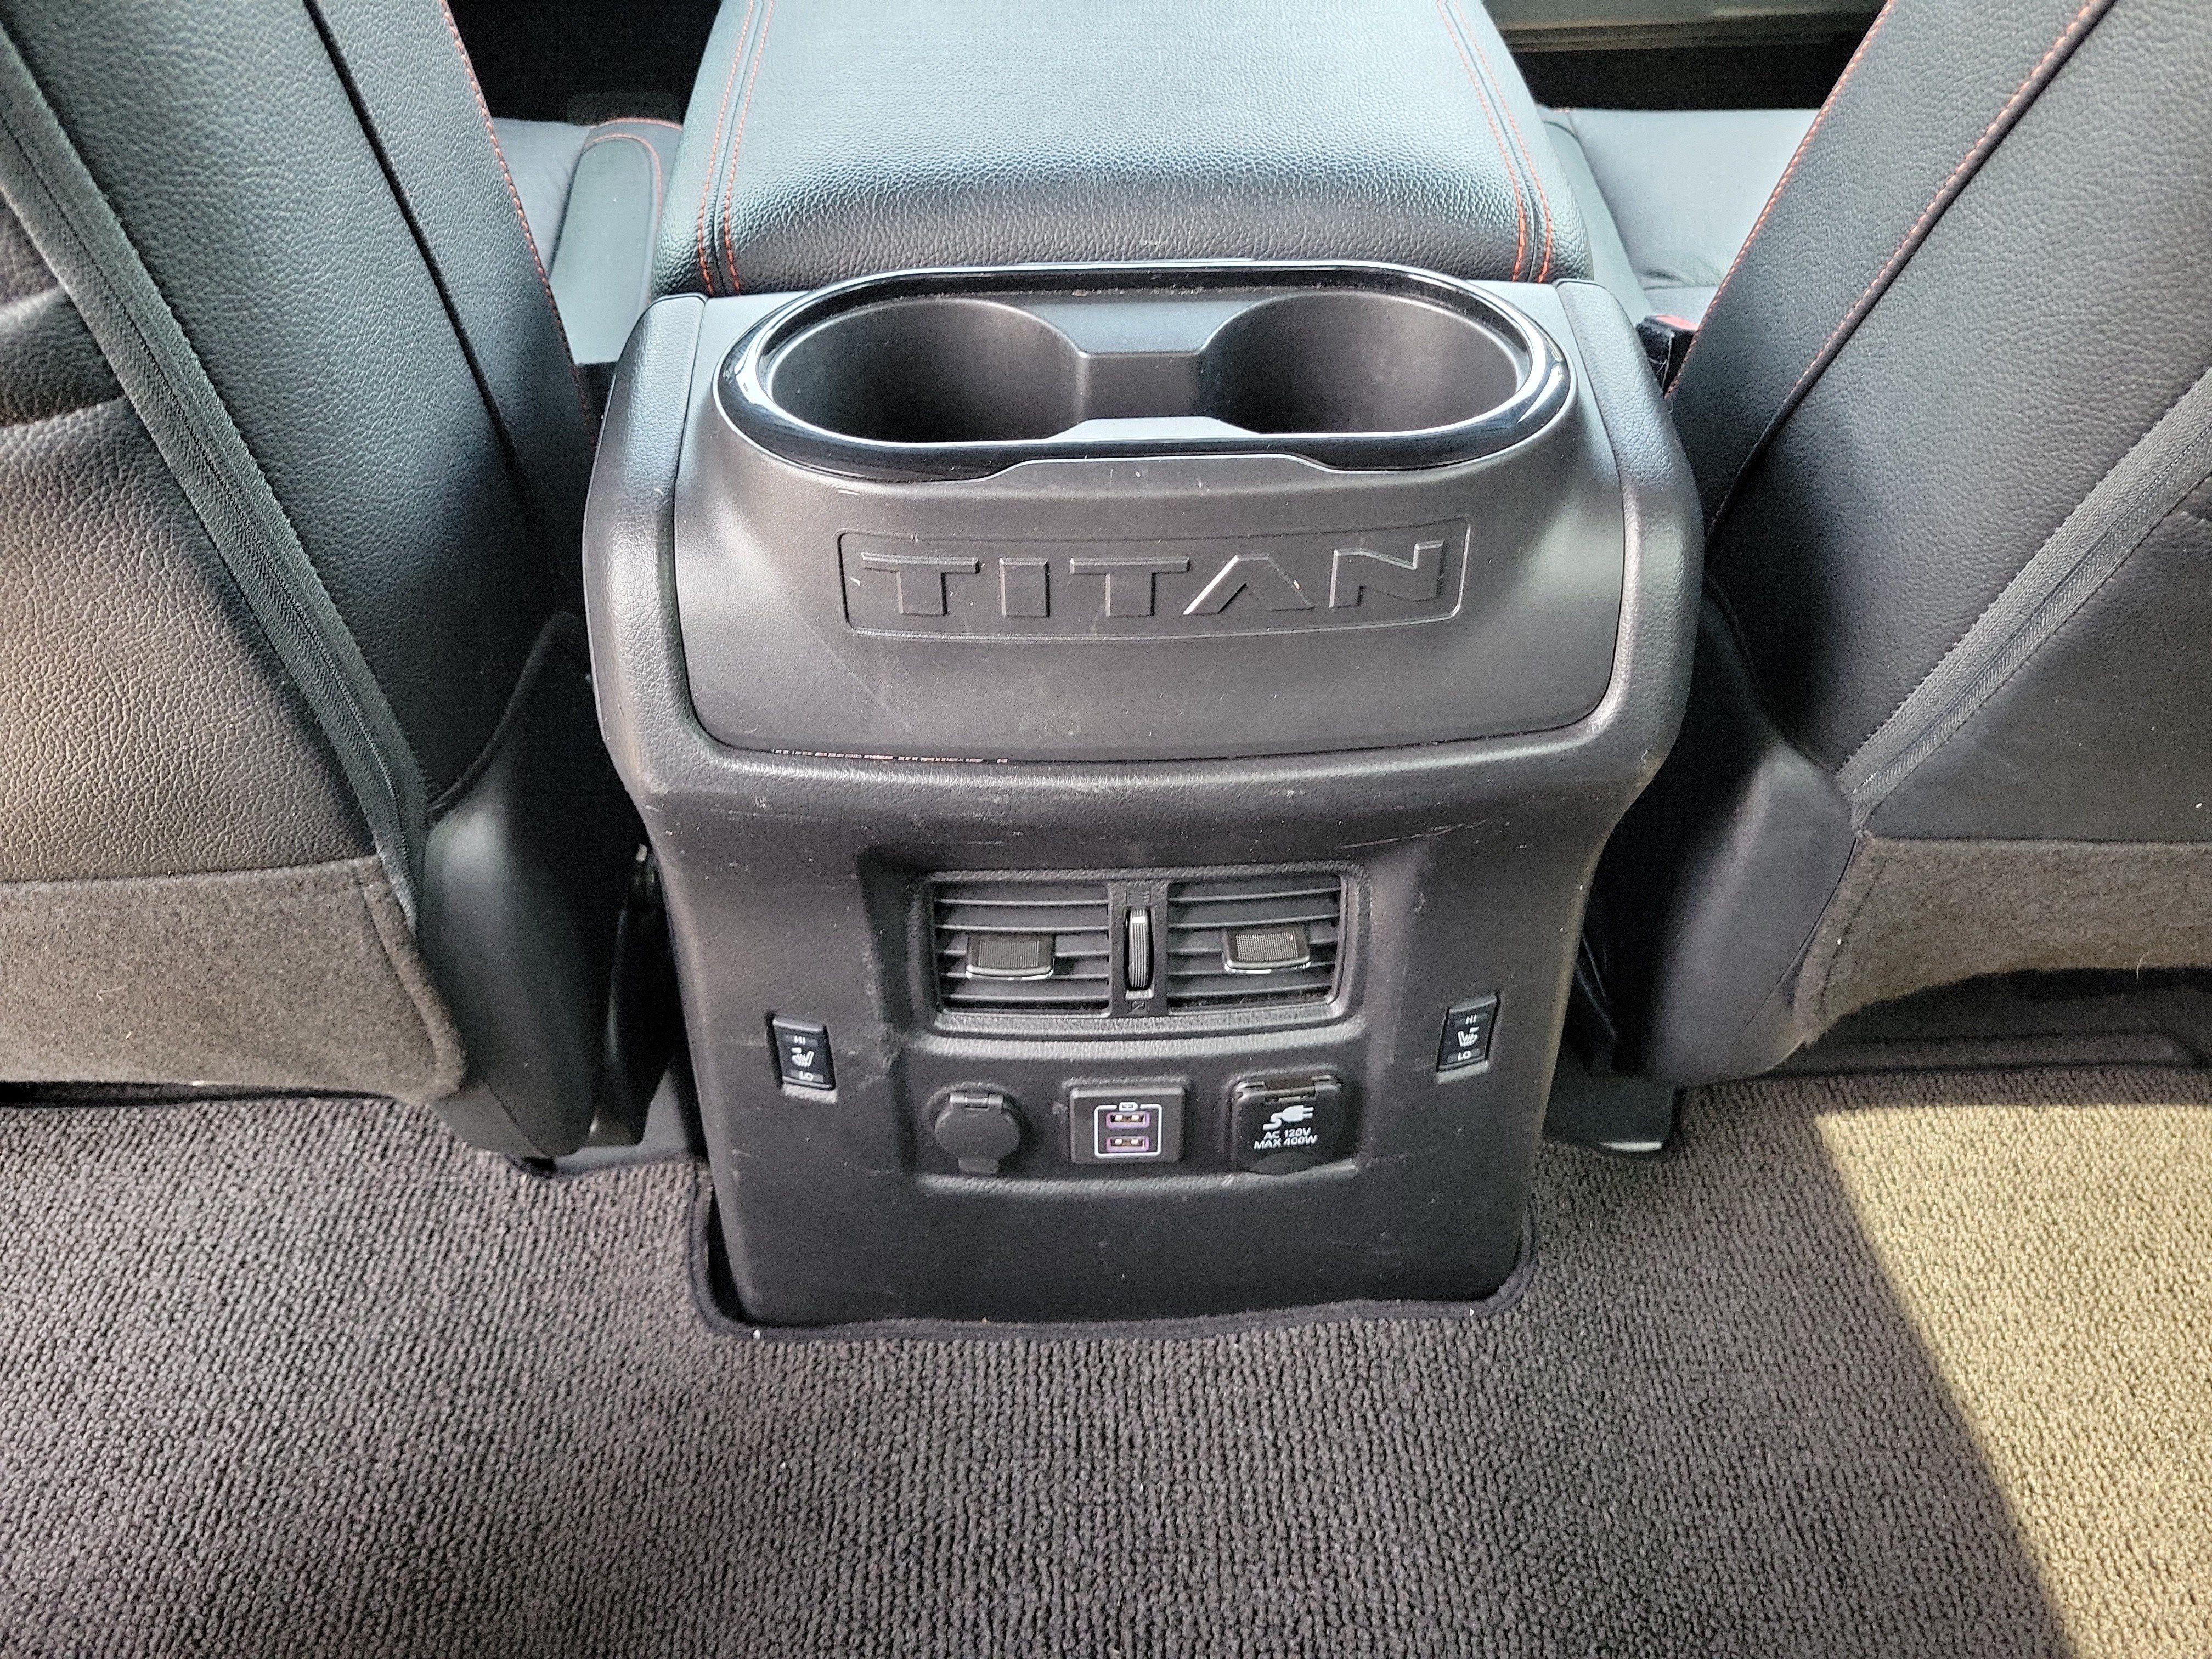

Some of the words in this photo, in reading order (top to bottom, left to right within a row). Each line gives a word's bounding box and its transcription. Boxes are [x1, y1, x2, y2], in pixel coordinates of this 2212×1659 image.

[861, 540, 1444, 618] TITAN
[1465, 1014, 1477, 1025] HI
[1457, 1050, 1471, 1061] LO
[799, 1071, 814, 1081] LO
[1263, 1130, 1280, 1140] AC
[1284, 1127, 1312, 1138] 120V
[1254, 1138, 1282, 1150] MAX
[1283, 1135, 1318, 1148] 400W
